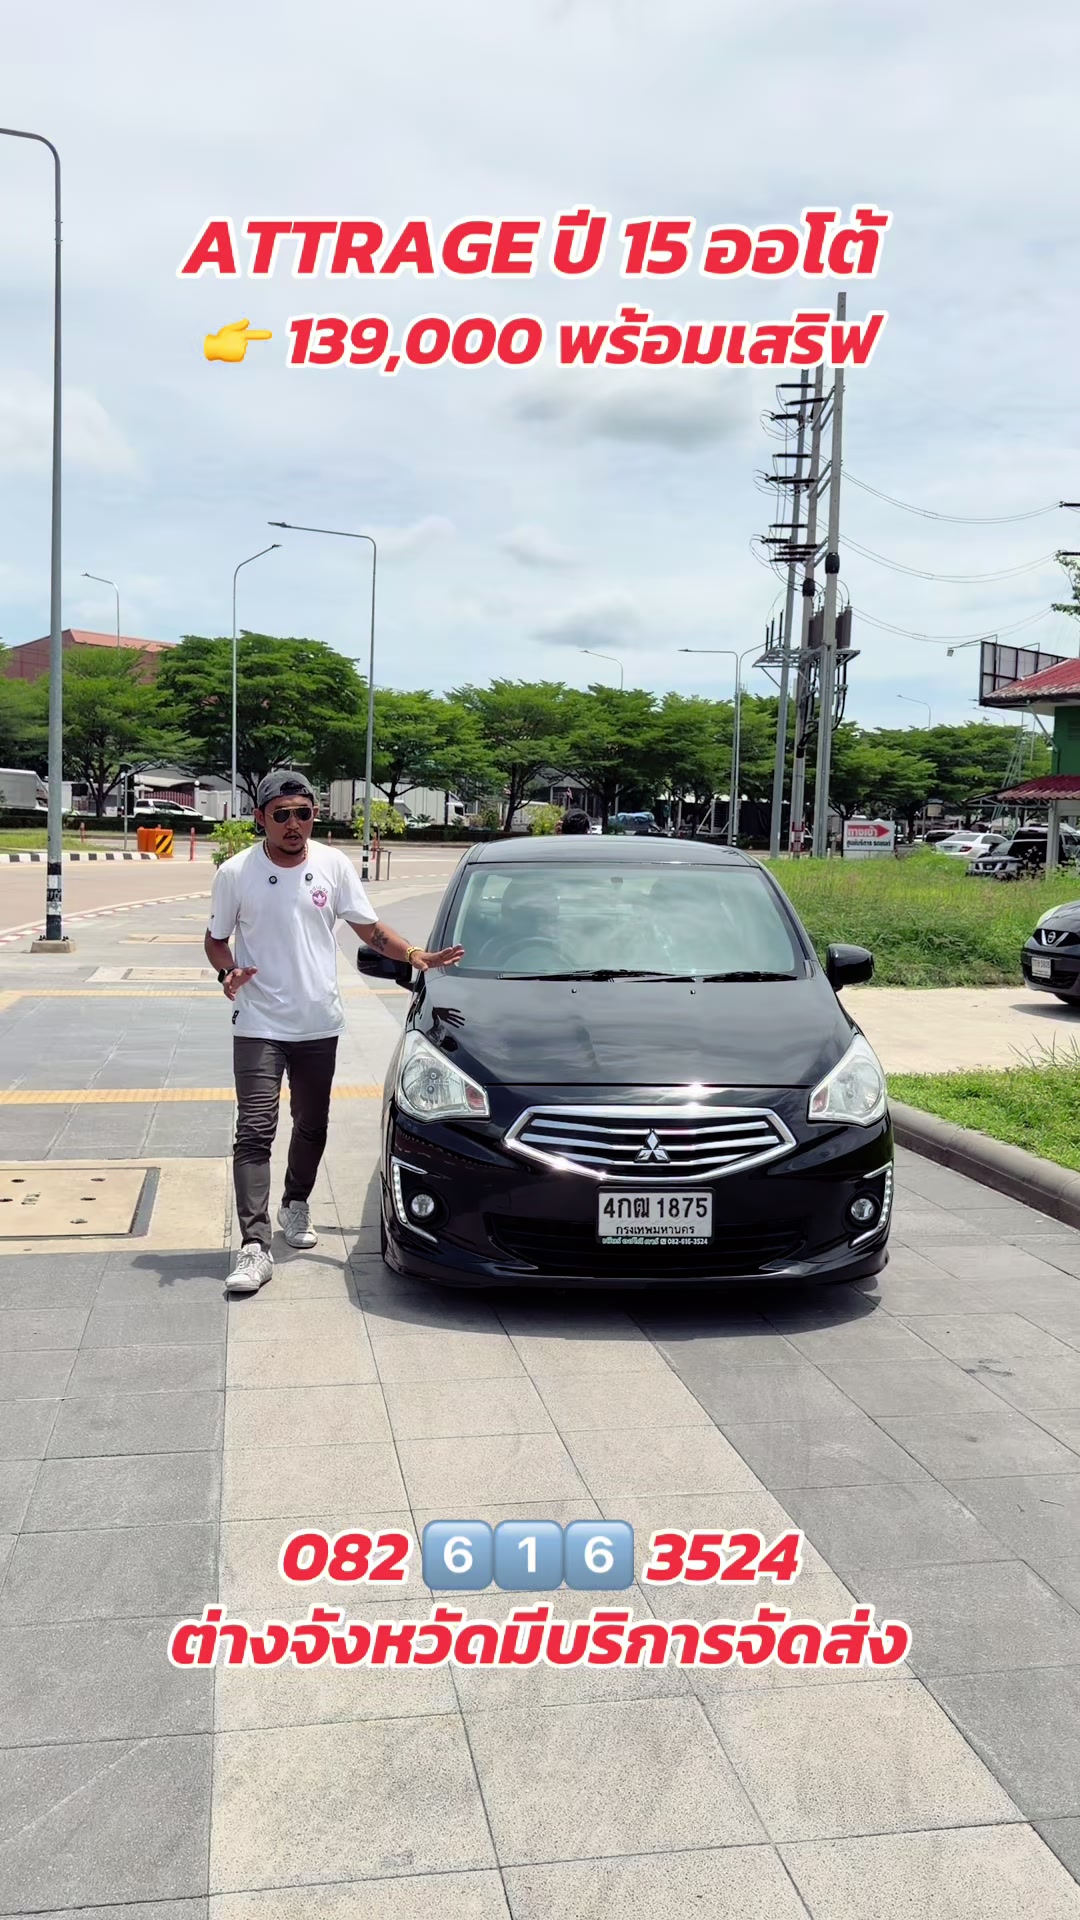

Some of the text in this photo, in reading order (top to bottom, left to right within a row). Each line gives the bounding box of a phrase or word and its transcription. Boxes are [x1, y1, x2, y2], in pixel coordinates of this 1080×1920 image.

[847, 825, 878, 837] ทางเข้า
[656, 1197, 708, 1218] 1875
[615, 1225, 695, 1236] กรุงเทพมหานคร
